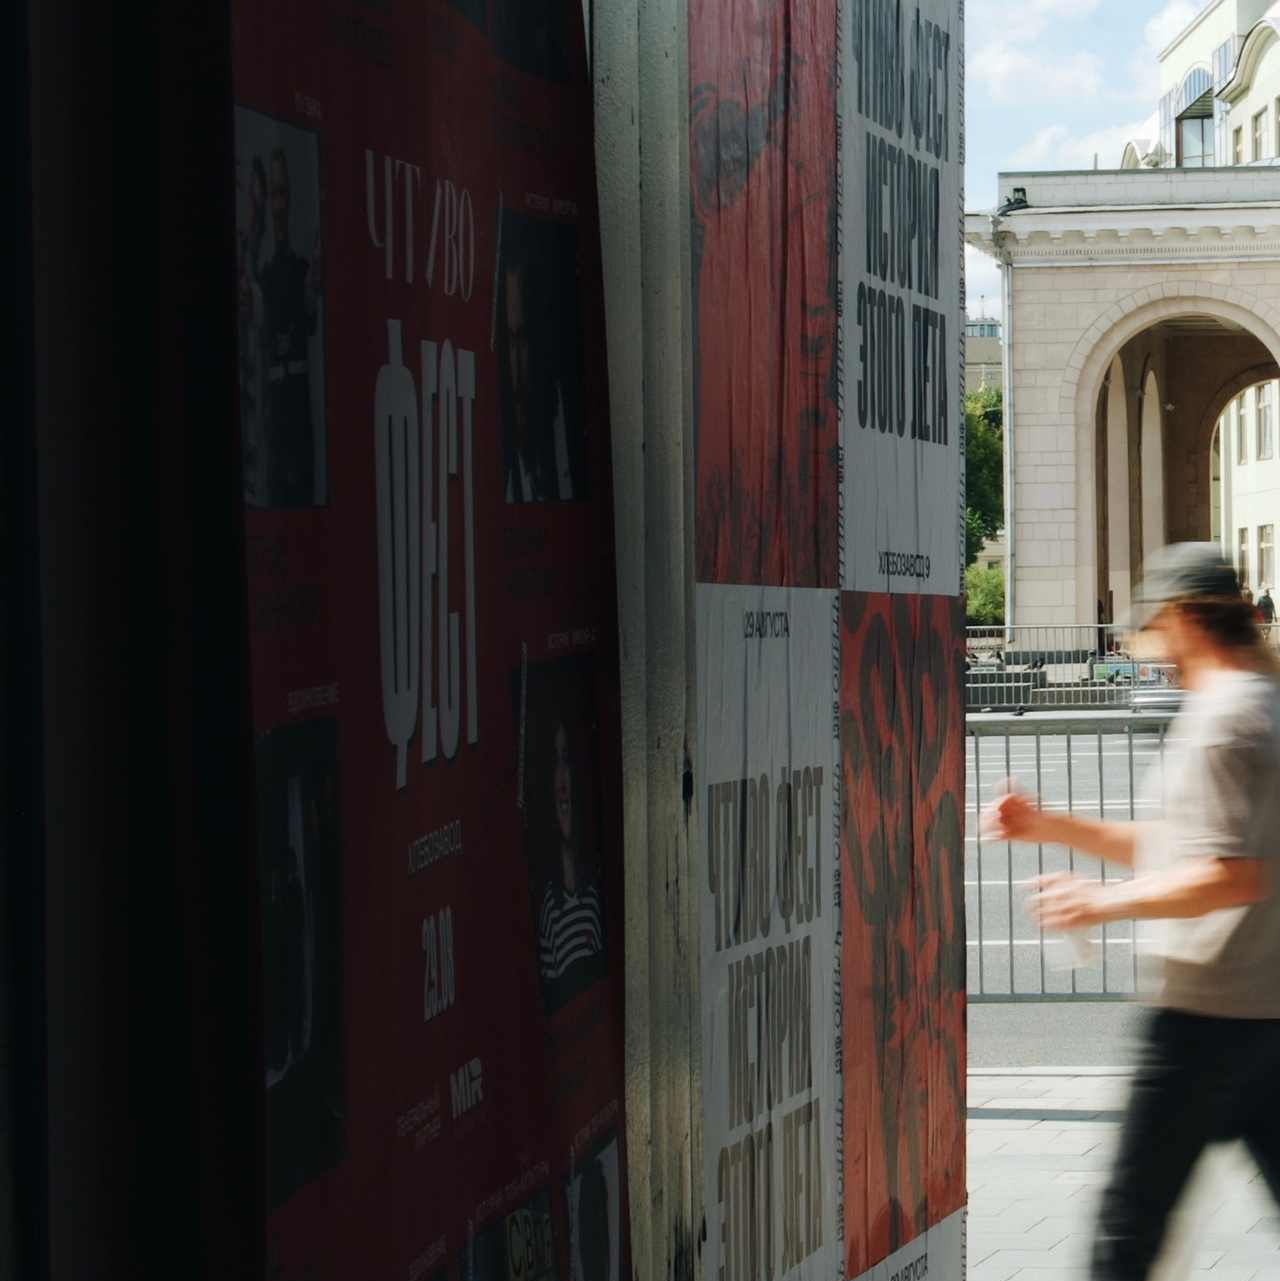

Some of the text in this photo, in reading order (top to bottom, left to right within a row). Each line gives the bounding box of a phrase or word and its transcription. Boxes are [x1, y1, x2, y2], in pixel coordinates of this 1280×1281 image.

[910, 6, 950, 162] ФЕСТ
[865, 131, 940, 300] ИСТОРИЯ
[857, 281, 949, 446] ЭТОГО ЛЕТА
[373, 317, 481, 791] ФЕСТ
[745, 611, 789, 638] 29 АВГУСТА
[707, 766, 824, 952] ЧТИВО ФЕСТ
[421, 904, 456, 1022] 29.08
[728, 935, 812, 1131] ИСТОРИЯ
[782, 1098, 823, 1277] ЛЕТА
